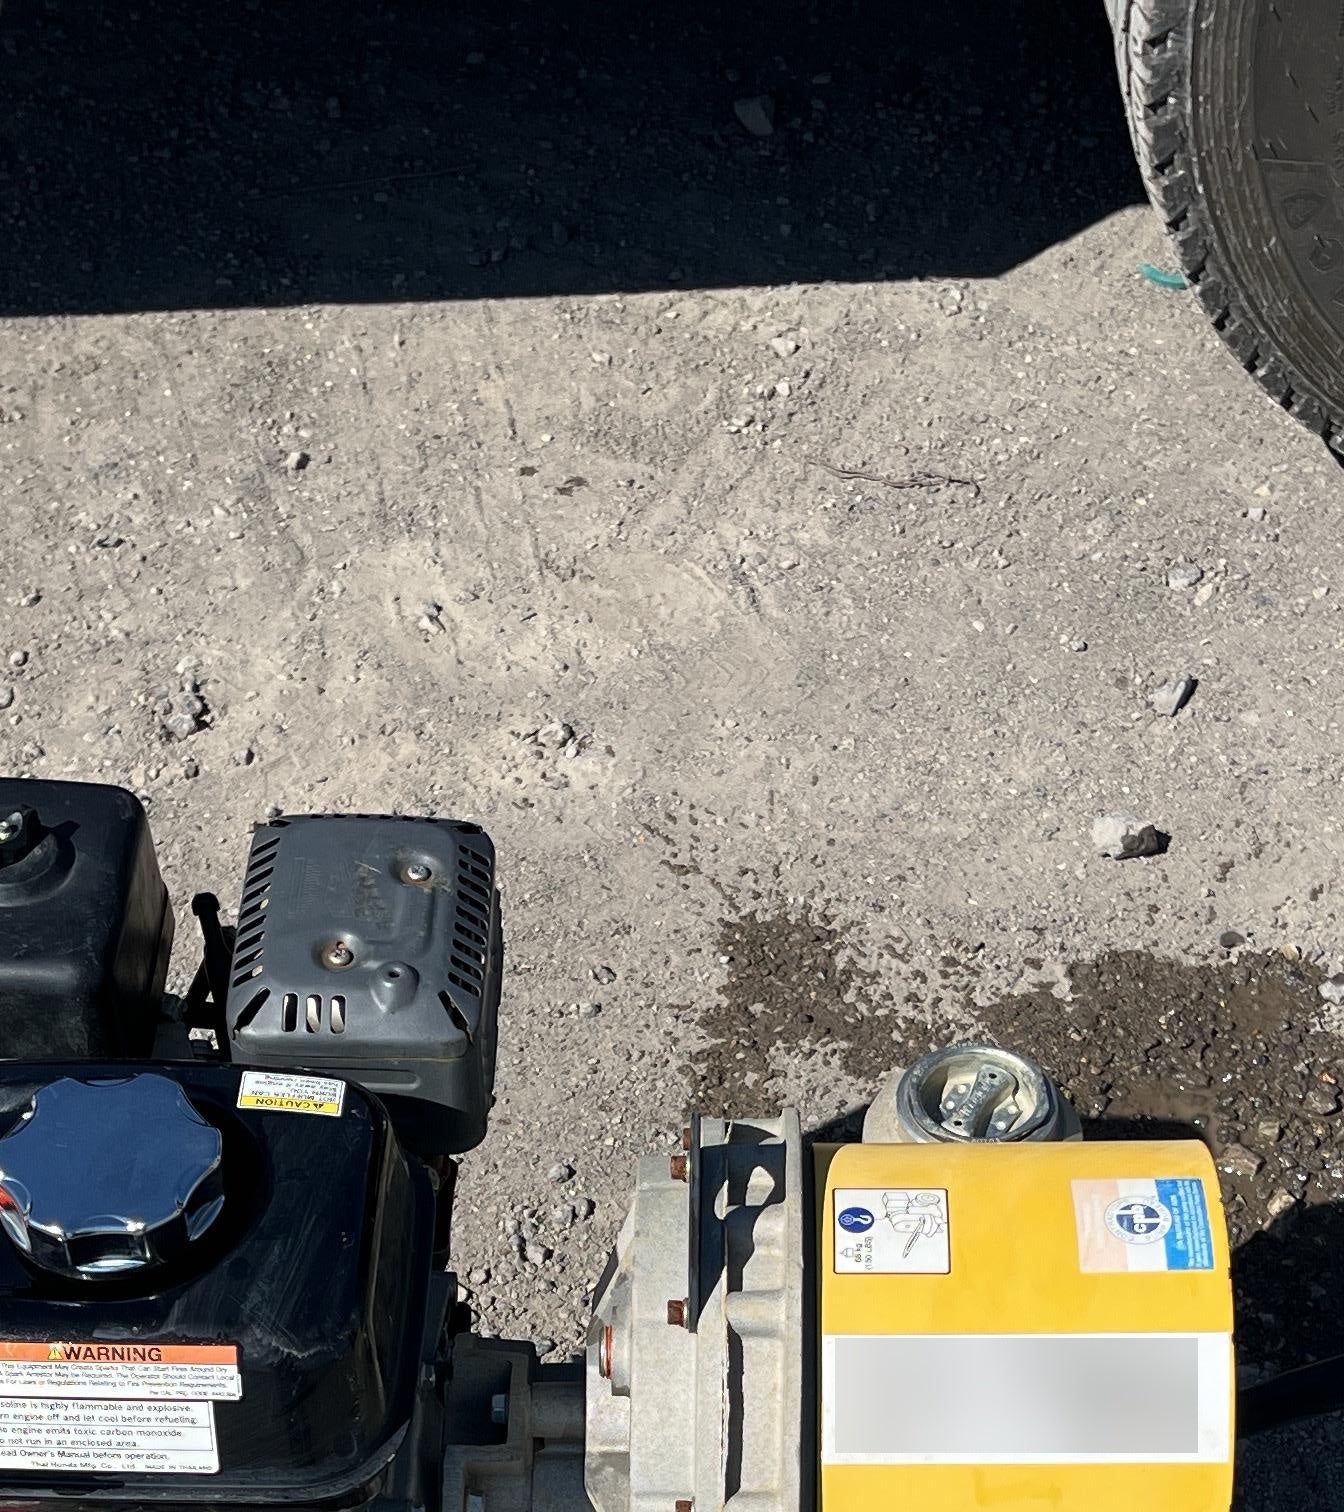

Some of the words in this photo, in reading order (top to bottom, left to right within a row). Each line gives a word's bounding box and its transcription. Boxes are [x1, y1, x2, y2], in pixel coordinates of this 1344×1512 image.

[256, 1098, 311, 1108] CAUTION
[1116, 1204, 1160, 1234] cpb
[62, 1346, 162, 1362] WARNING
[30, 1401, 38, 1409] is
[40, 1401, 69, 1411] highly
[72, 1401, 122, 1410] flammable
[126, 1403, 144, 1411] and
[147, 1404, 194, 1413] explosive.
[13, 1413, 44, 1421] engine
[63, 1413, 80, 1421] and
[121, 1415, 152, 1423] before
[11, 1426, 42, 1435] engine
[46, 1427, 71, 1435] emits
[74, 1427, 96, 1435] toxic
[100, 1428, 133, 1436] carbon
[71, 1439, 112, 1447] enclosed
[19, 1449, 55, 1458] Owner's
[57, 1450, 90, 1458] Manual
[93, 1451, 122, 1459] before
[125, 1452, 170, 1460] operation.
